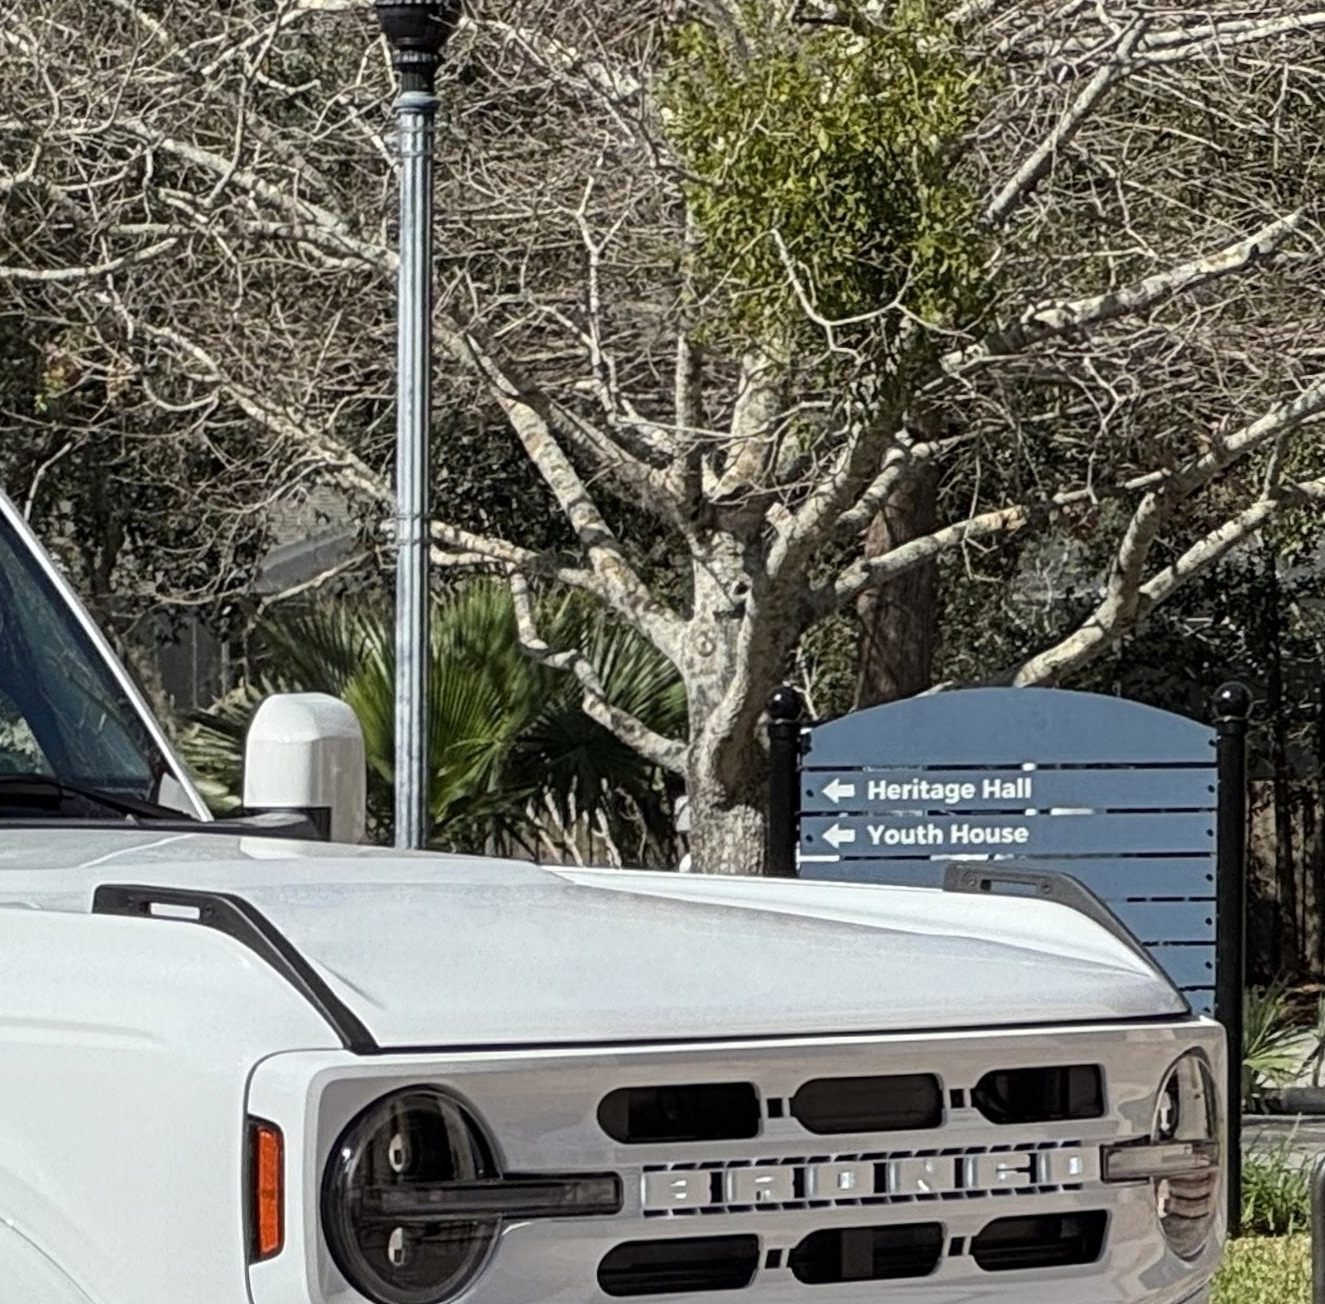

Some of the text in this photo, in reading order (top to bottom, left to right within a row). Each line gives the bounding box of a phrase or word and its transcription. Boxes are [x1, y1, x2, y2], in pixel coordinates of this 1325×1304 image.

[867, 776, 1033, 804] Heritage Hall
[866, 823, 1030, 845] Youth House
[640, 1143, 1096, 1216] BRONCO
